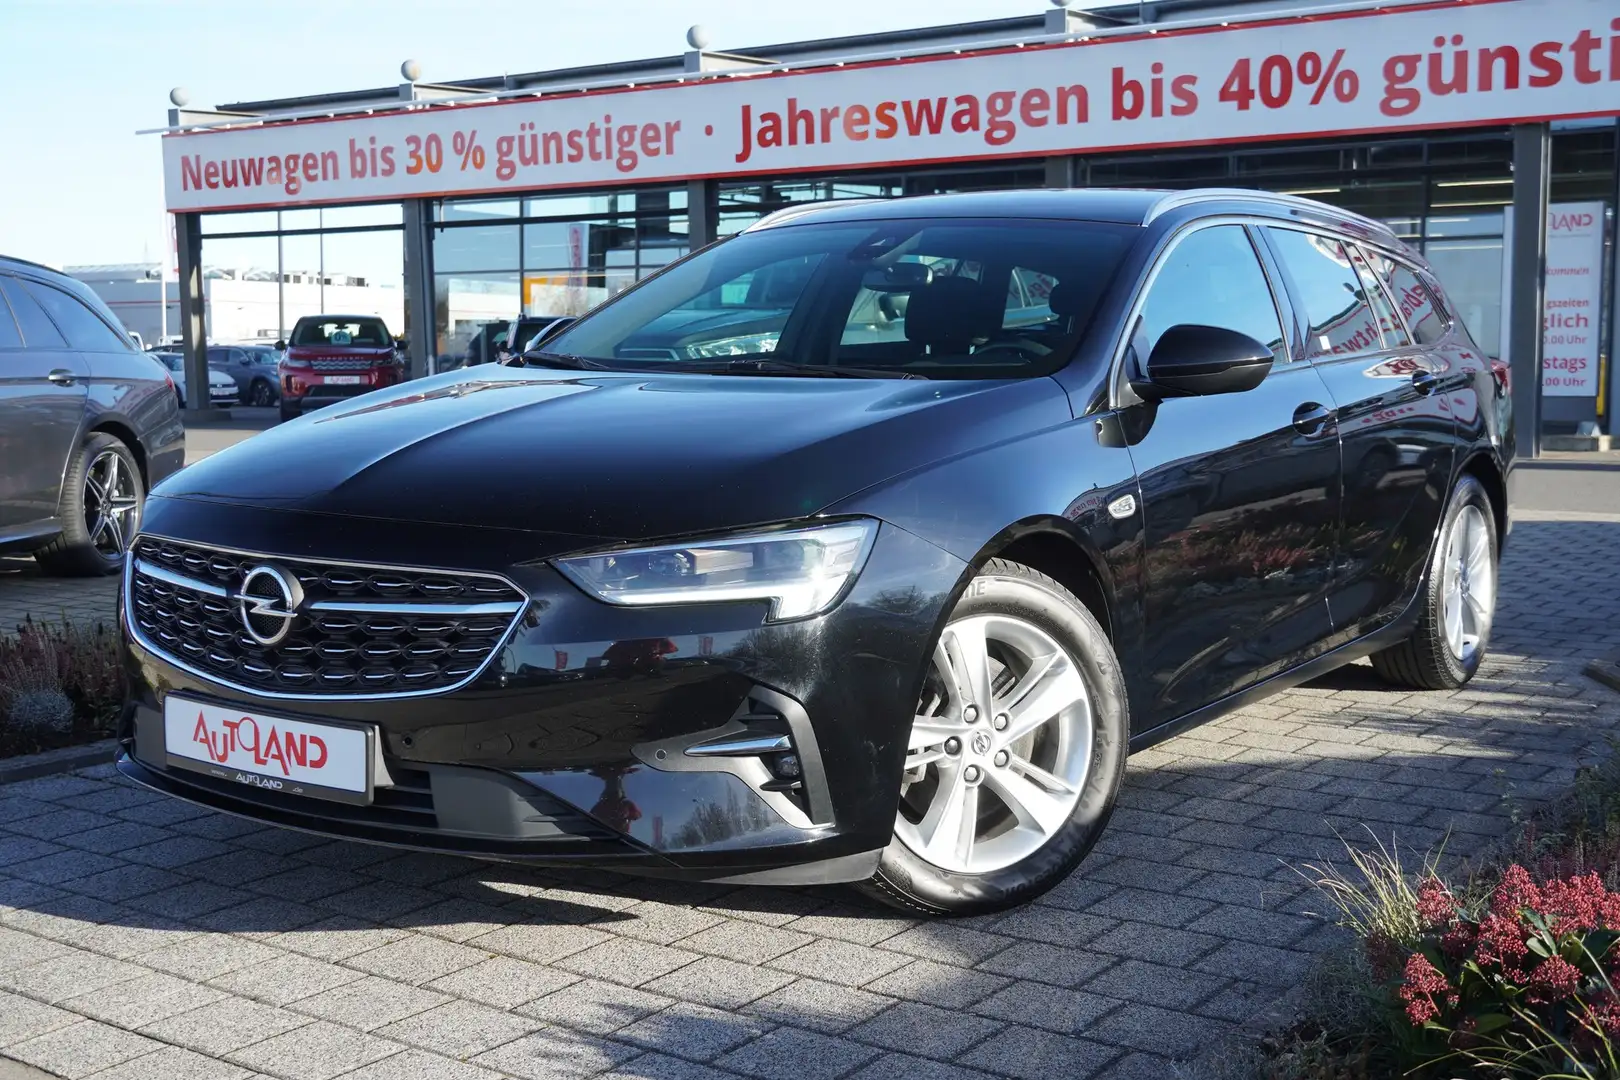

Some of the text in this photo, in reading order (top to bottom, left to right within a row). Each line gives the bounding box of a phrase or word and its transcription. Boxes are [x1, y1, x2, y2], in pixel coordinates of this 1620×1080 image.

[181, 152, 339, 195] Neuwagen
[350, 138, 395, 178] bis
[405, 133, 443, 175] 30
[454, 130, 486, 171] %
[495, 115, 681, 181] günstiger
[735, 83, 1089, 163] Jahreswagen
[1111, 62, 1198, 121] bis
[1219, 48, 1360, 111] 40%
[1566, 335, 1588, 345] Uhr
[1563, 377, 1587, 387] Uhr
[193, 710, 328, 775] AUTOLAND
[236, 772, 283, 789] AUTOLAND
